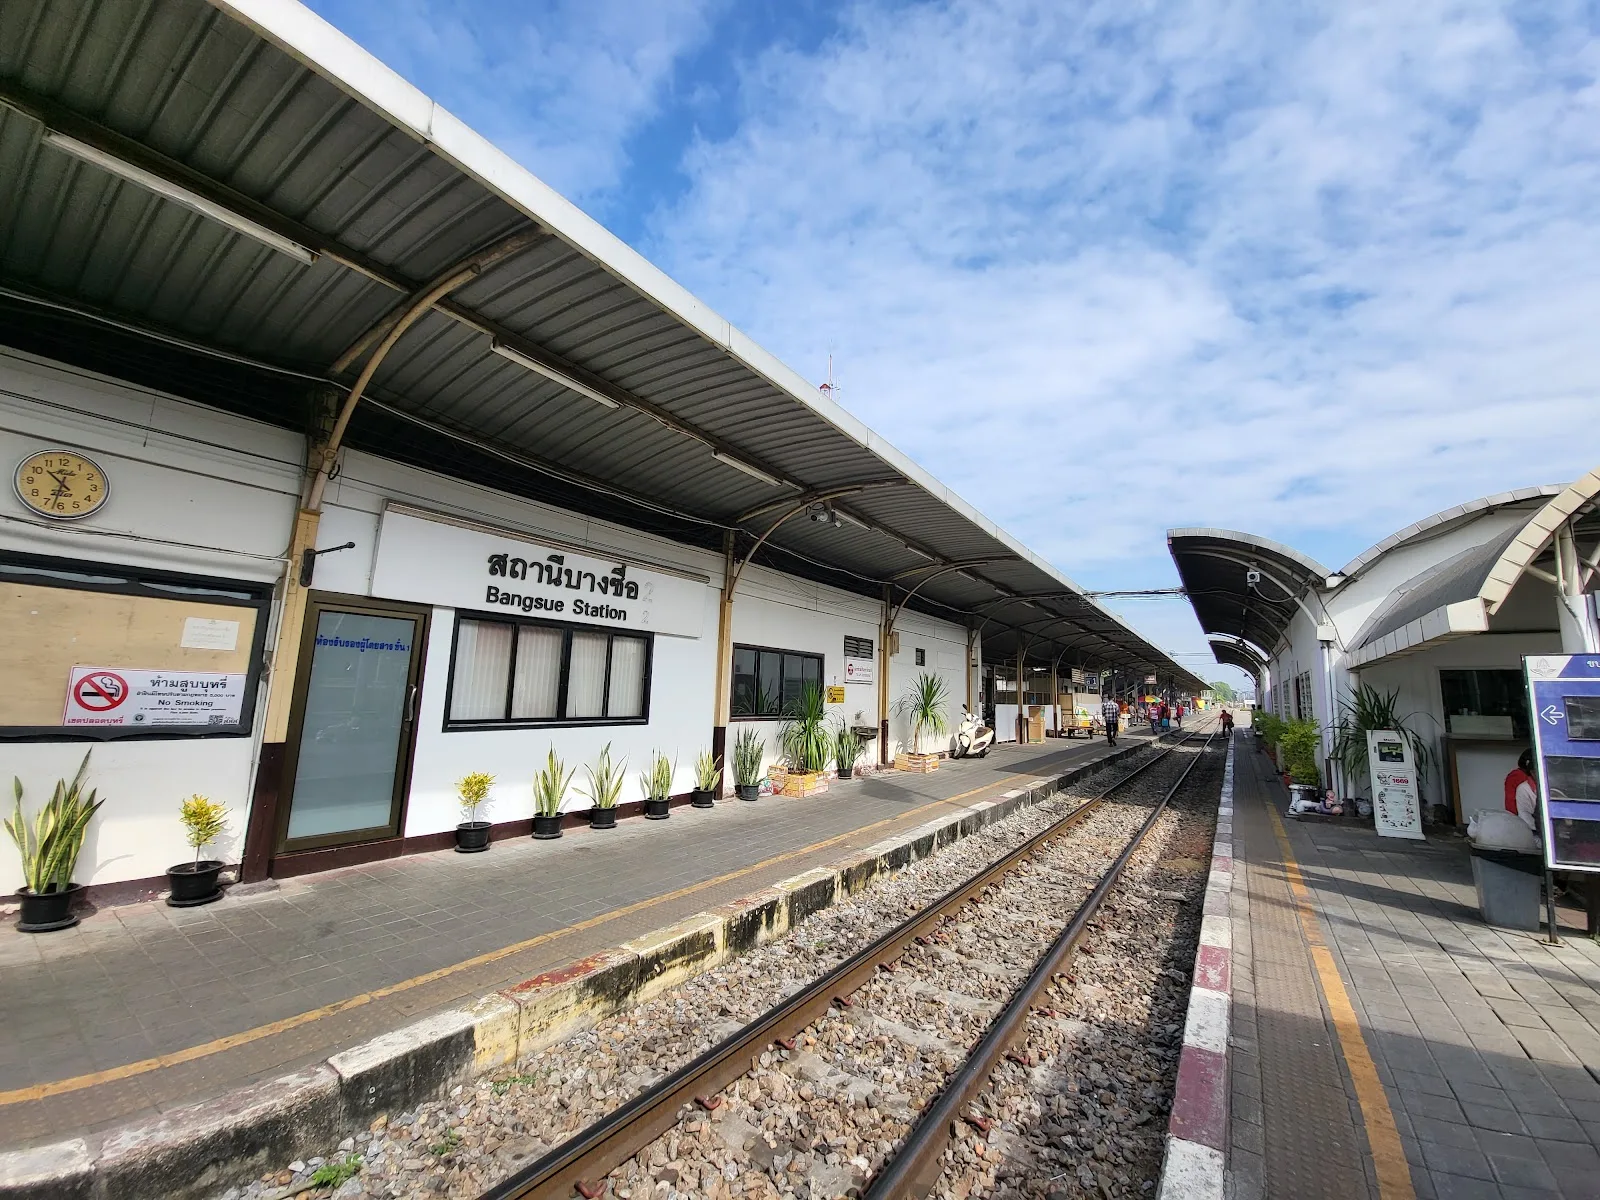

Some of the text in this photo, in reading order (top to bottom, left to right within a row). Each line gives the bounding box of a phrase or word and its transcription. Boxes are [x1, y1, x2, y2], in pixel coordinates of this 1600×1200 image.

[45, 459, 53, 467] 11
[32, 466, 43, 474] 10
[26, 476, 34, 484] 9
[31, 488, 39, 496] 8
[90, 484, 98, 492] 3
[57, 502, 65, 510] 6
[487, 553, 640, 600] สถานีบางซื่อ
[485, 585, 565, 612] Bangsue
[572, 598, 627, 621] Station
[150, 675, 228, 692] ห้ามสูบบุหรี่
